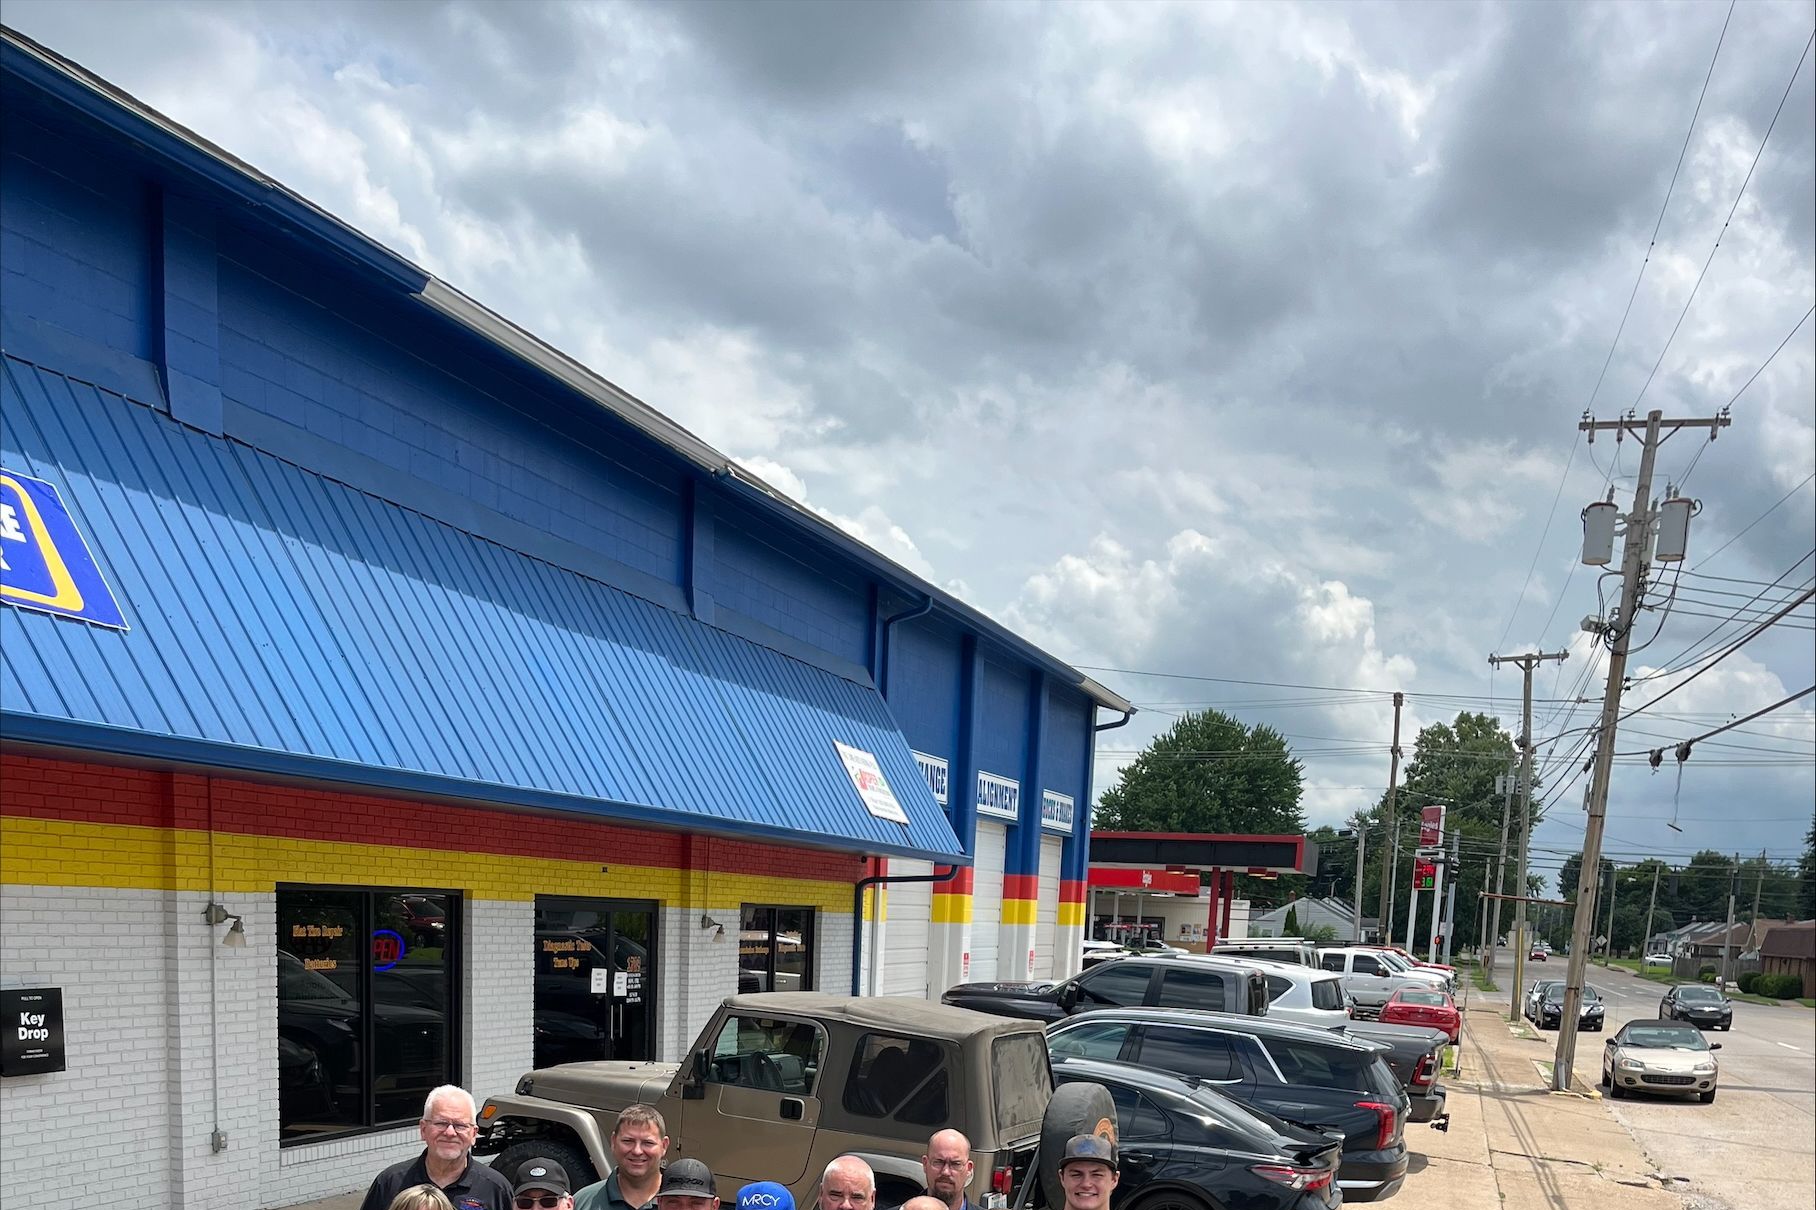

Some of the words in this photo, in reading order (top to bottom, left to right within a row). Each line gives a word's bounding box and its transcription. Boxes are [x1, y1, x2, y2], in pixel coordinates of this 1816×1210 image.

[977, 779, 1017, 812] ALIGNMENT
[373, 939, 400, 961] PEN
[20, 1012, 45, 1027] Key
[18, 1027, 49, 1041] Drop
[742, 1193, 780, 1207] MRCY
